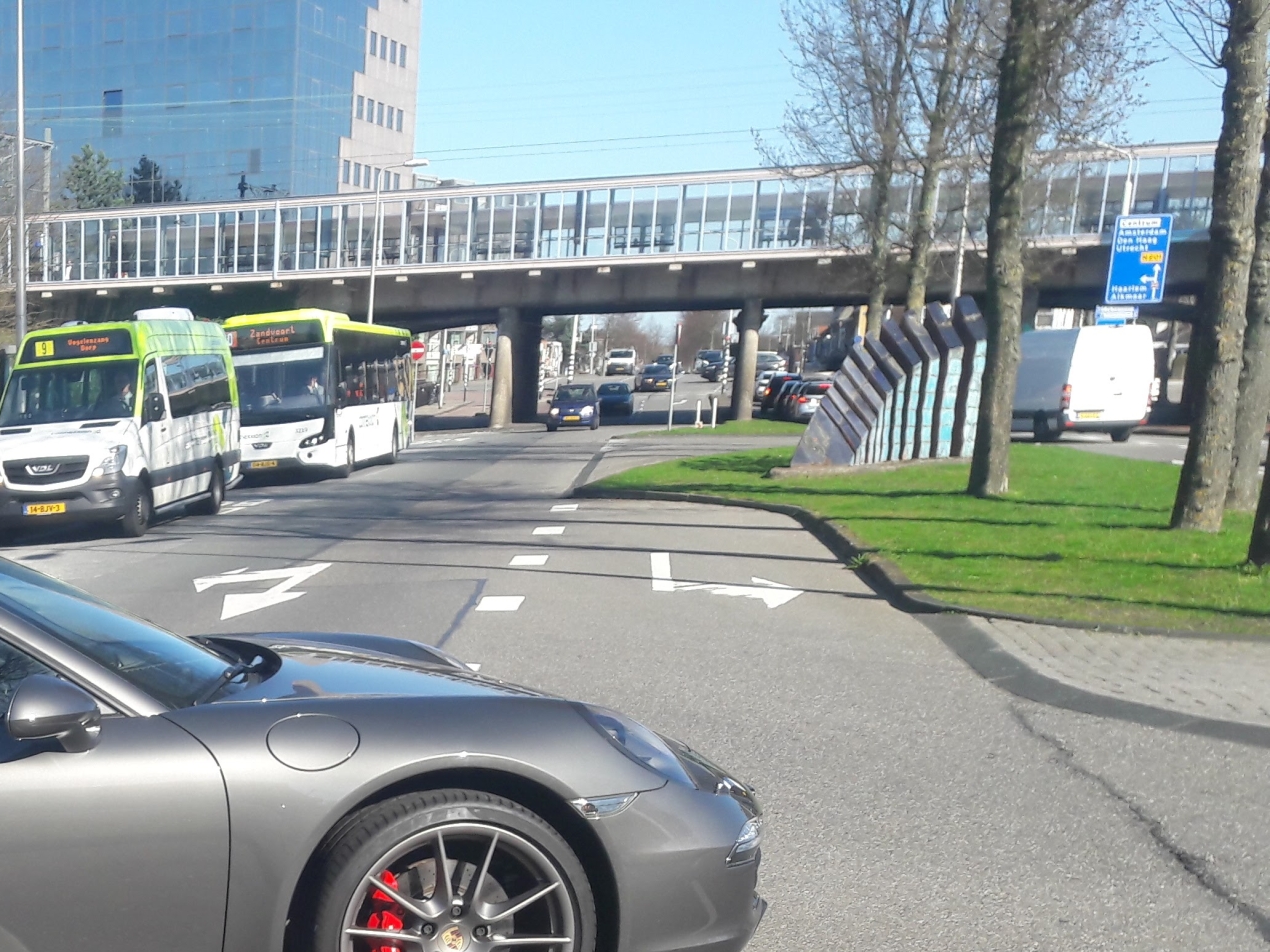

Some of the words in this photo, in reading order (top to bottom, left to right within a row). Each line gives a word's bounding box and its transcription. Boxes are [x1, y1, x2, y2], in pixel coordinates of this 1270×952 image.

[1122, 219, 1159, 227] Centrum
[1118, 228, 1168, 237] Amsterdam
[1116, 236, 1134, 245] Den
[1135, 235, 1158, 245] Haag
[1115, 244, 1149, 252] Utrecht
[1111, 284, 1148, 293] Haarlem
[1110, 293, 1147, 301] Alkmaar
[249, 325, 296, 338] Zandvoort
[256, 336, 289, 345] Centrum
[41, 342, 48, 355] 9
[31, 463, 54, 472] VDL
[29, 503, 61, 514] 14-BJV-3
